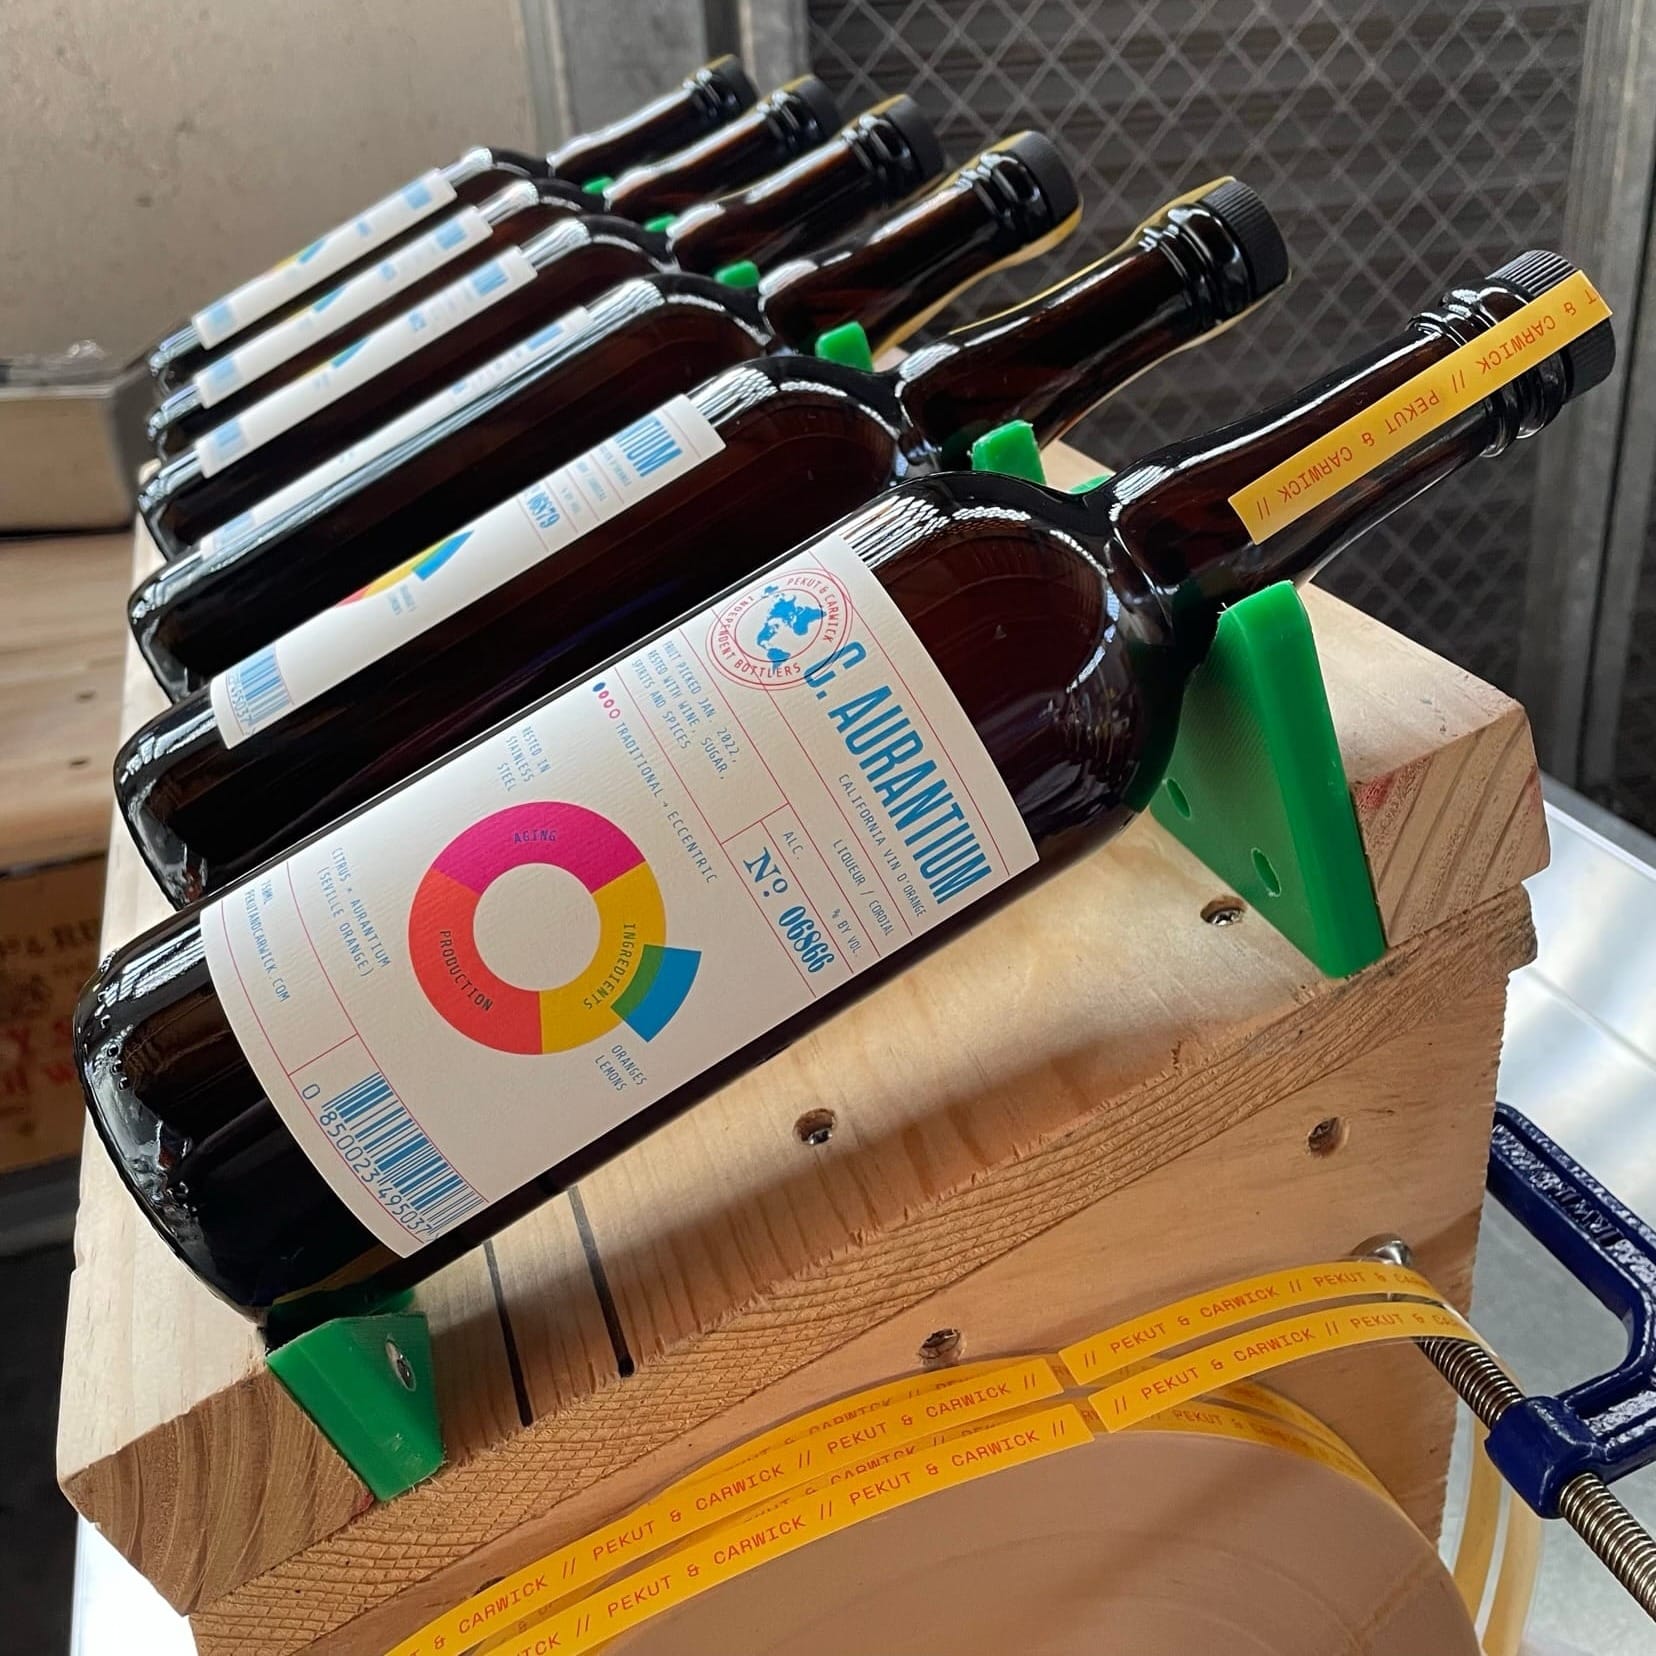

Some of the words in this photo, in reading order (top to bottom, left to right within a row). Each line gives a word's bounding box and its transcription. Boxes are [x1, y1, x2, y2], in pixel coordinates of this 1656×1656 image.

[1476, 316, 1556, 374] CARWICK
[1564, 303, 1577, 317] &
[1362, 432, 1375, 447] &
[1385, 390, 1439, 434] PEKUT
[1278, 447, 1353, 503] CARWICK
[717, 597, 754, 661] INDEPENDENT
[824, 593, 838, 642] CARWICK
[630, 658, 656, 689] SPIRITS
[649, 689, 666, 708] AND
[661, 709, 691, 749] SPICES
[663, 639, 682, 661] FRUIT
[676, 661, 702, 695] PICKED
[697, 697, 716, 722] JAN.
[715, 726, 740, 763] 2022,
[734, 660, 802, 677] BOTTLERS
[803, 641, 866, 699] C.
[505, 735, 535, 783] STAINLESS
[521, 725, 543, 757] RESTED
[536, 758, 551, 773] IN
[662, 674, 683, 699] WITH
[677, 700, 700, 733] WINE,
[700, 736, 728, 780] SUGAR,
[496, 761, 517, 792] STEEL
[615, 721, 663, 798] TRADITIONAL
[666, 810, 717, 883] ECCENTRIC
[828, 685, 992, 904] AURANTIUM
[513, 829, 557, 844] AGING
[838, 773, 886, 846] CALIFORNIA
[882, 847, 902, 871] VIN
[895, 872, 927, 917] D'ORANGE
[317, 866, 345, 918] (SEVILLE
[338, 921, 374, 977] ORANGE)
[331, 846, 351, 882] CITRUS
[350, 898, 391, 968] AURANTIUM
[782, 830, 804, 860] ALC.
[836, 919, 852, 934] BY
[832, 838, 866, 886] LIQUEUR
[867, 898, 894, 936] CORDIAL
[439, 929, 493, 1012] PRODUCTION
[583, 922, 637, 1011] INGREDIENTS
[778, 905, 834, 973] 06866
[594, 1054, 627, 1091] LEMONS
[610, 1043, 647, 1085] ORANGES
[301, 1083, 321, 1099] 0
[319, 1111, 379, 1183] 850023
[377, 1188, 433, 1235] 495037
[1109, 1322, 1167, 1354] PEKUT
[1177, 1315, 1190, 1326] &
[1199, 1285, 1281, 1319] CARWICK
[1312, 1271, 1367, 1289] PEKUT
[1141, 1366, 1199, 1401] PEKUT
[1210, 1358, 1225, 1370] &
[1233, 1328, 1317, 1364] CARWICK
[1349, 1312, 1406, 1330] PEKUT
[433, 1635, 446, 1649] &
[459, 1576, 548, 1634] CARWICK
[593, 1520, 656, 1562] PEKUT
[669, 1510, 682, 1523] &
[695, 1463, 785, 1510] CARWICK
[827, 1422, 888, 1455] PEKUT
[901, 1414, 913, 1427] &
[926, 1383, 1010, 1418] CARWICK
[607, 1575, 674, 1618] PEKUT
[686, 1563, 700, 1577] &
[713, 1515, 807, 1567] CARWICK
[850, 1471, 912, 1506] PEKUT
[925, 1463, 939, 1476] &
[951, 1430, 1041, 1467] CARWICK
